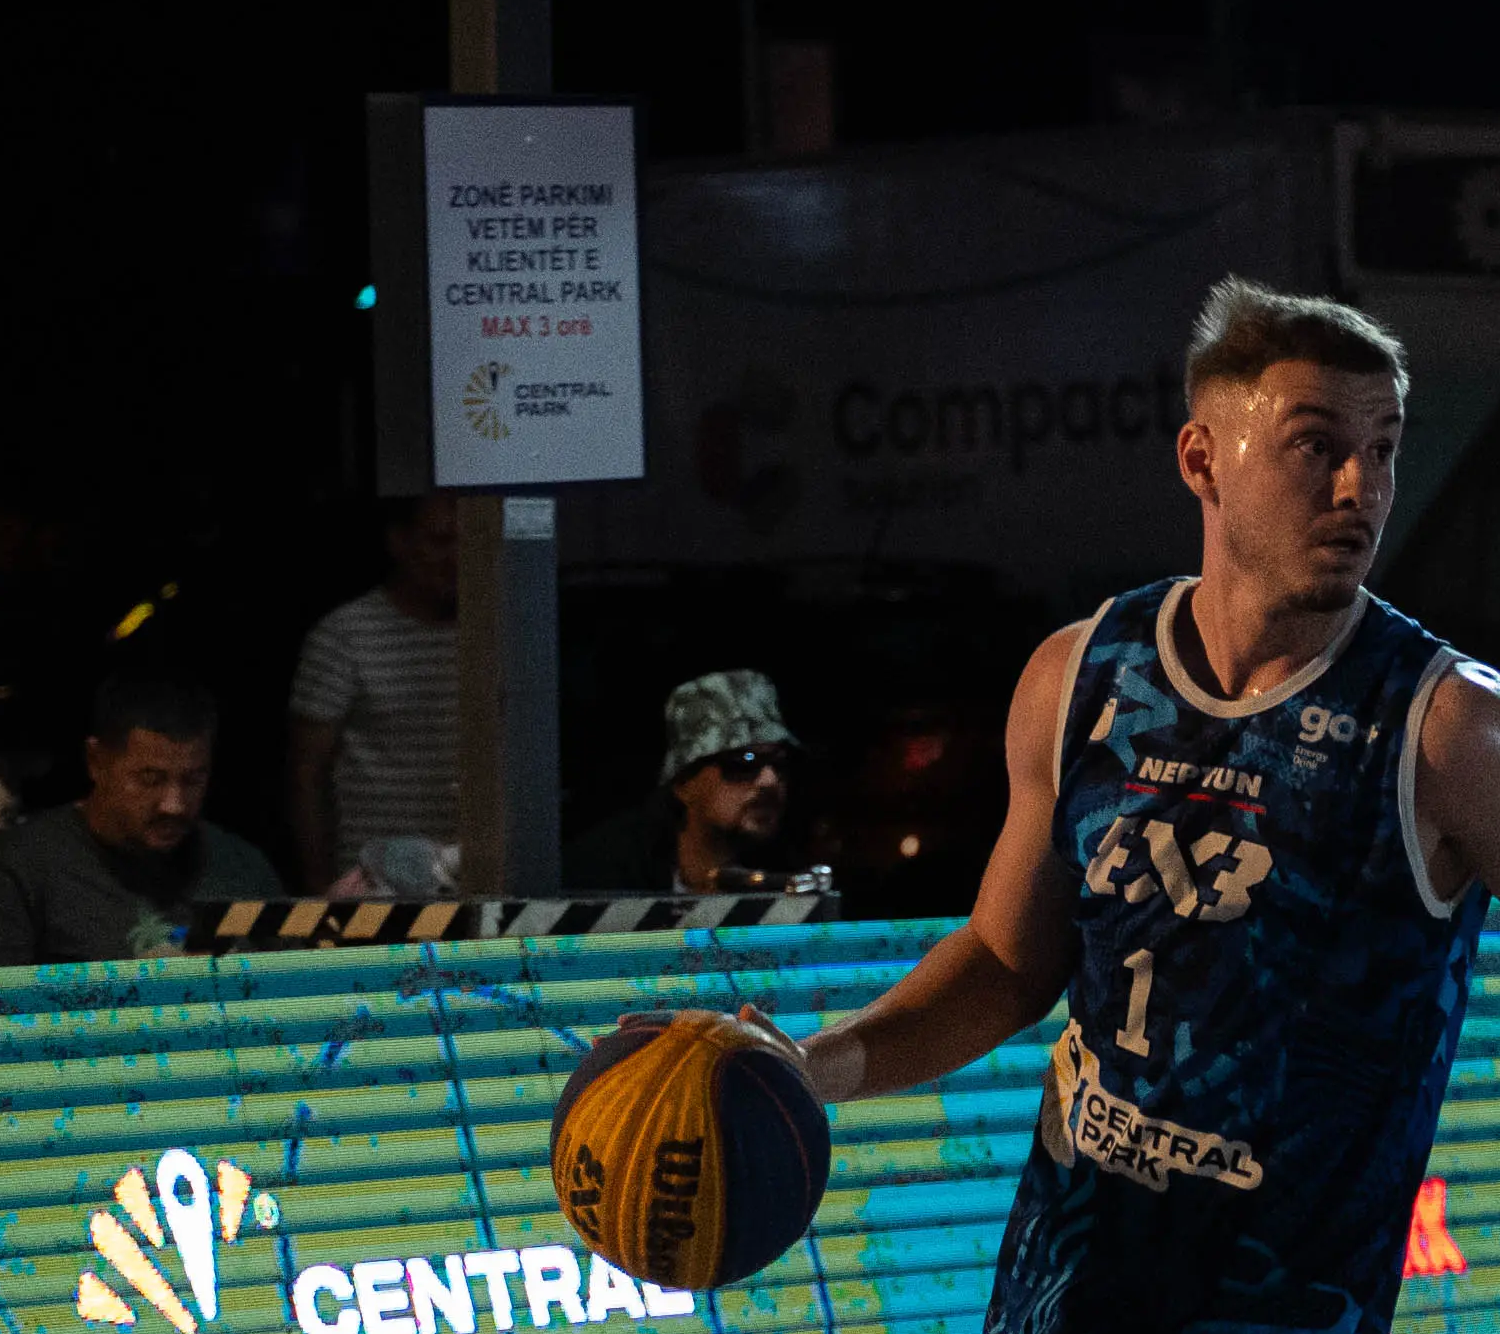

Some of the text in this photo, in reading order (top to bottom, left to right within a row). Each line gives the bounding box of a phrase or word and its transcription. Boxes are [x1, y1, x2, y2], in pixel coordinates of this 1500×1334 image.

[585, 248, 598, 271] E
[446, 281, 622, 307] CENTRAL PARK
[481, 316, 531, 339] MAX
[539, 316, 550, 337] 3
[515, 382, 613, 399] CENTRAL
[515, 401, 572, 417] PARK
[1115, 948, 1154, 1058] 1
